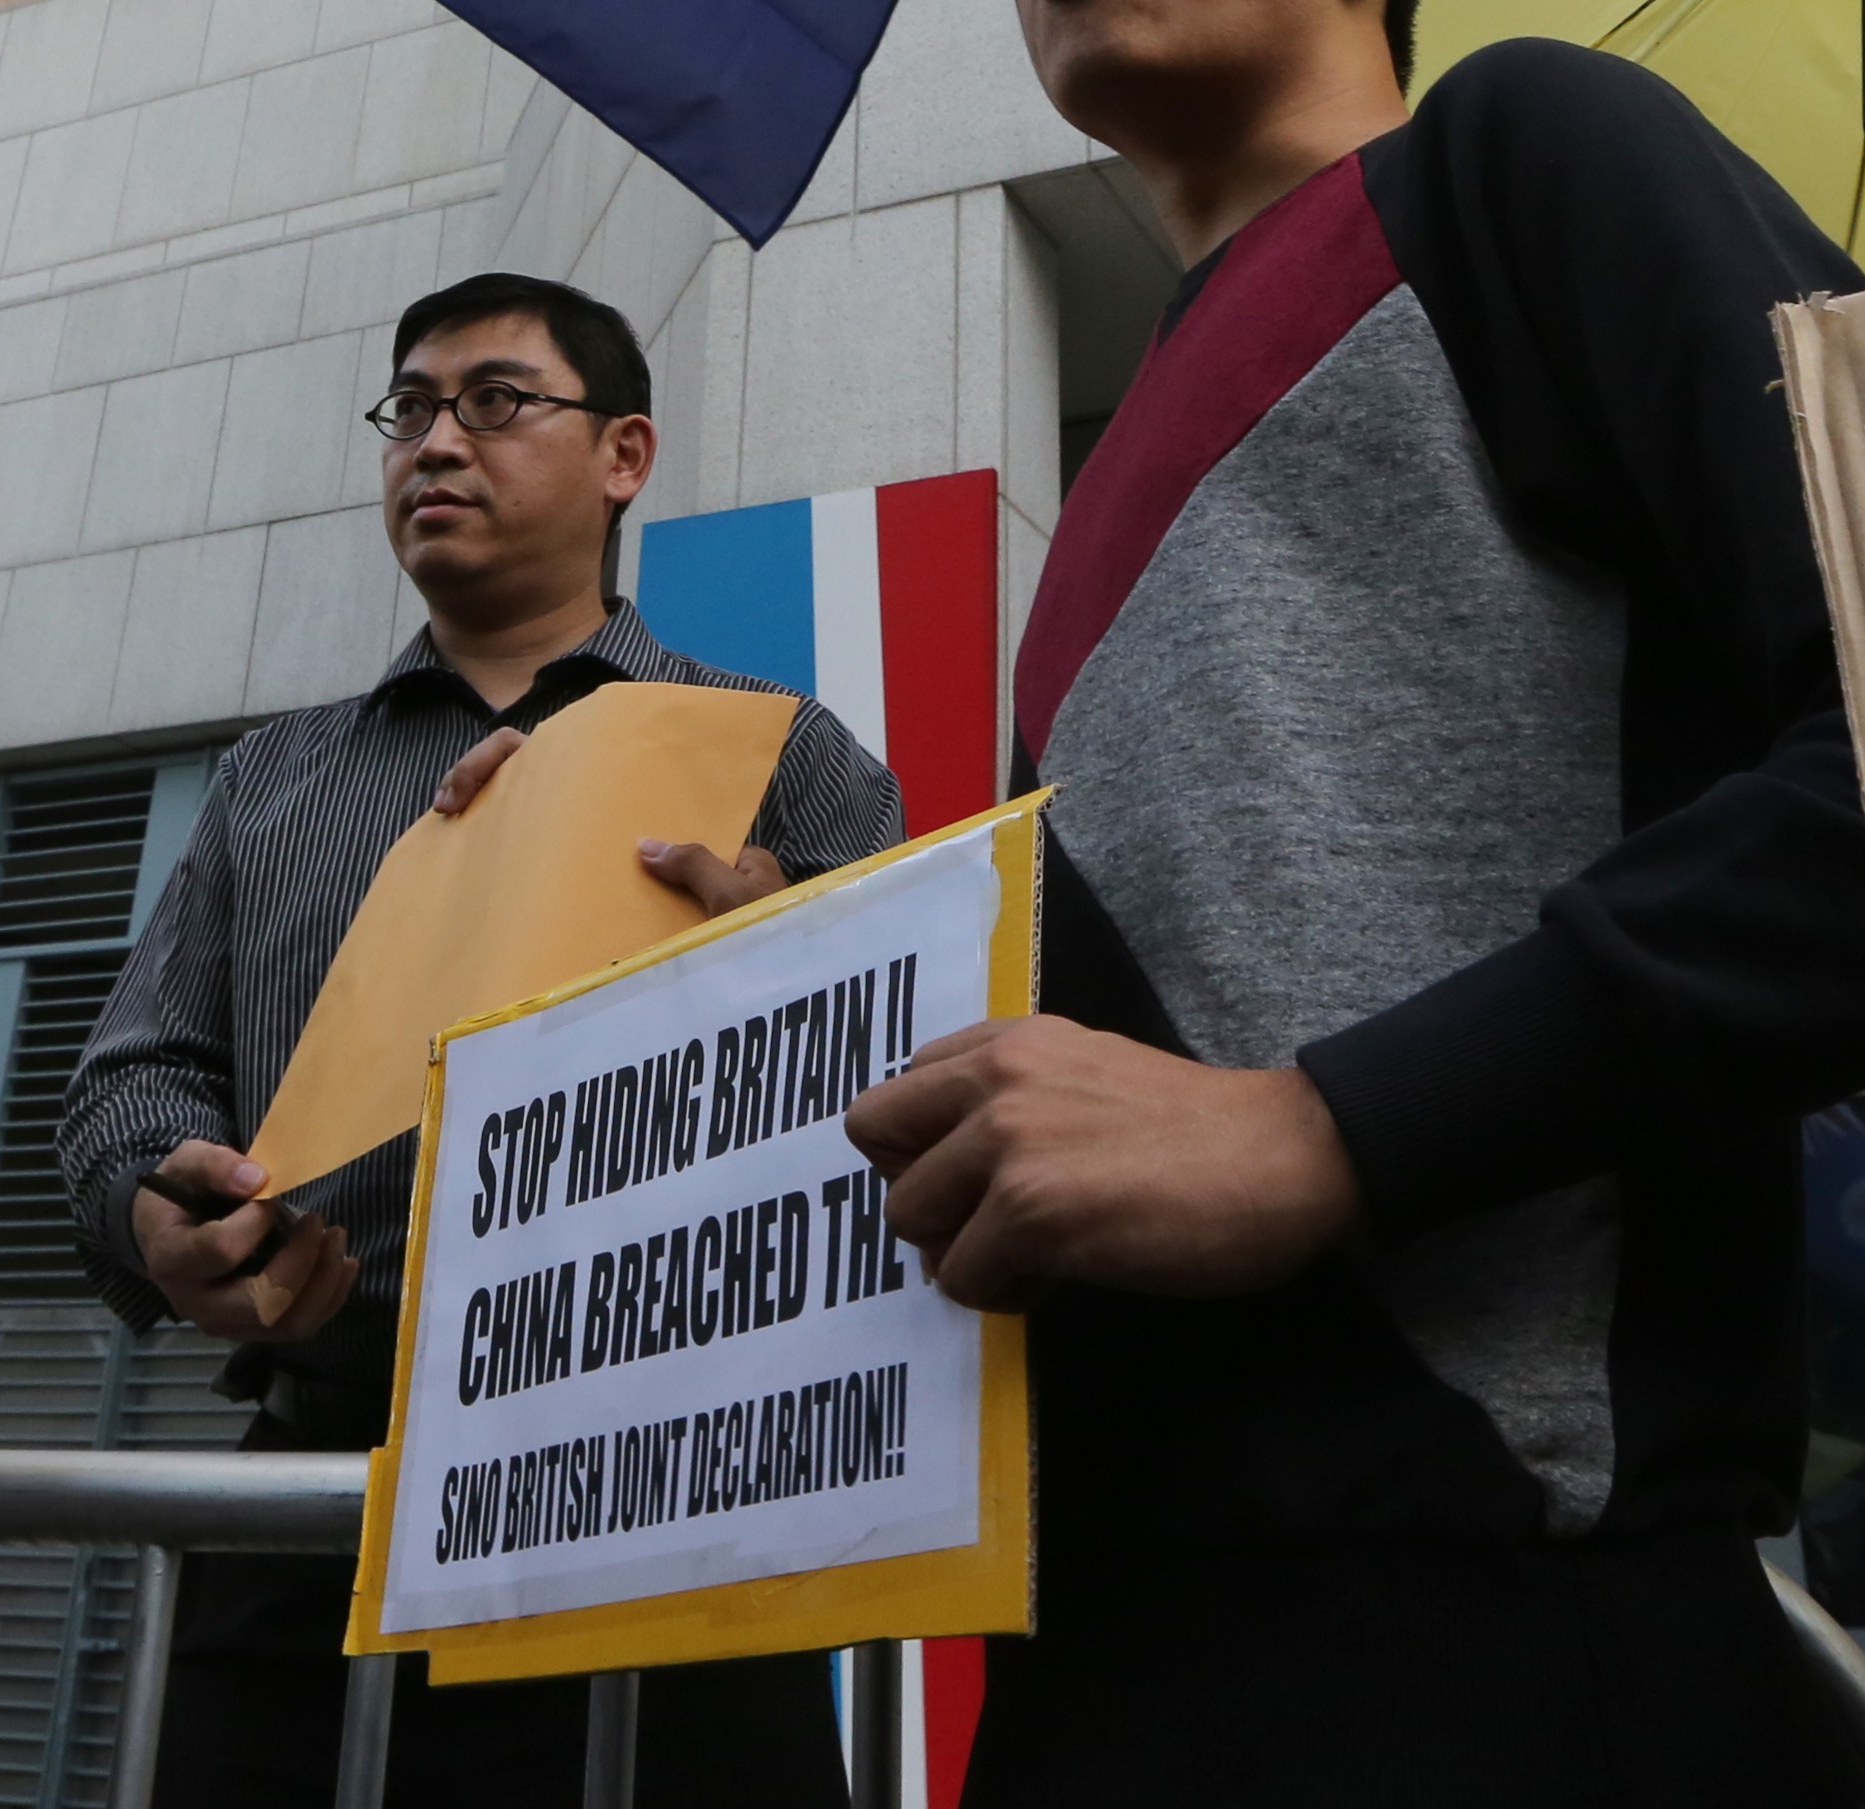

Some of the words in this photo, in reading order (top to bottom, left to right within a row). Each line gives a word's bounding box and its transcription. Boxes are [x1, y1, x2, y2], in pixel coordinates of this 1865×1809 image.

[472, 1090, 566, 1238] STOP
[565, 1037, 705, 1206] HIDING
[706, 967, 877, 1162] BRITAIN
[457, 1257, 576, 1405] CHINA
[580, 1190, 811, 1374] BREACHED
[821, 1162, 906, 1308] THE
[435, 1456, 501, 1566] SINO
[501, 1433, 607, 1561] BRITISH
[607, 1417, 687, 1536] JOINT
[686, 1362, 909, 1519] DECLARATION!!
